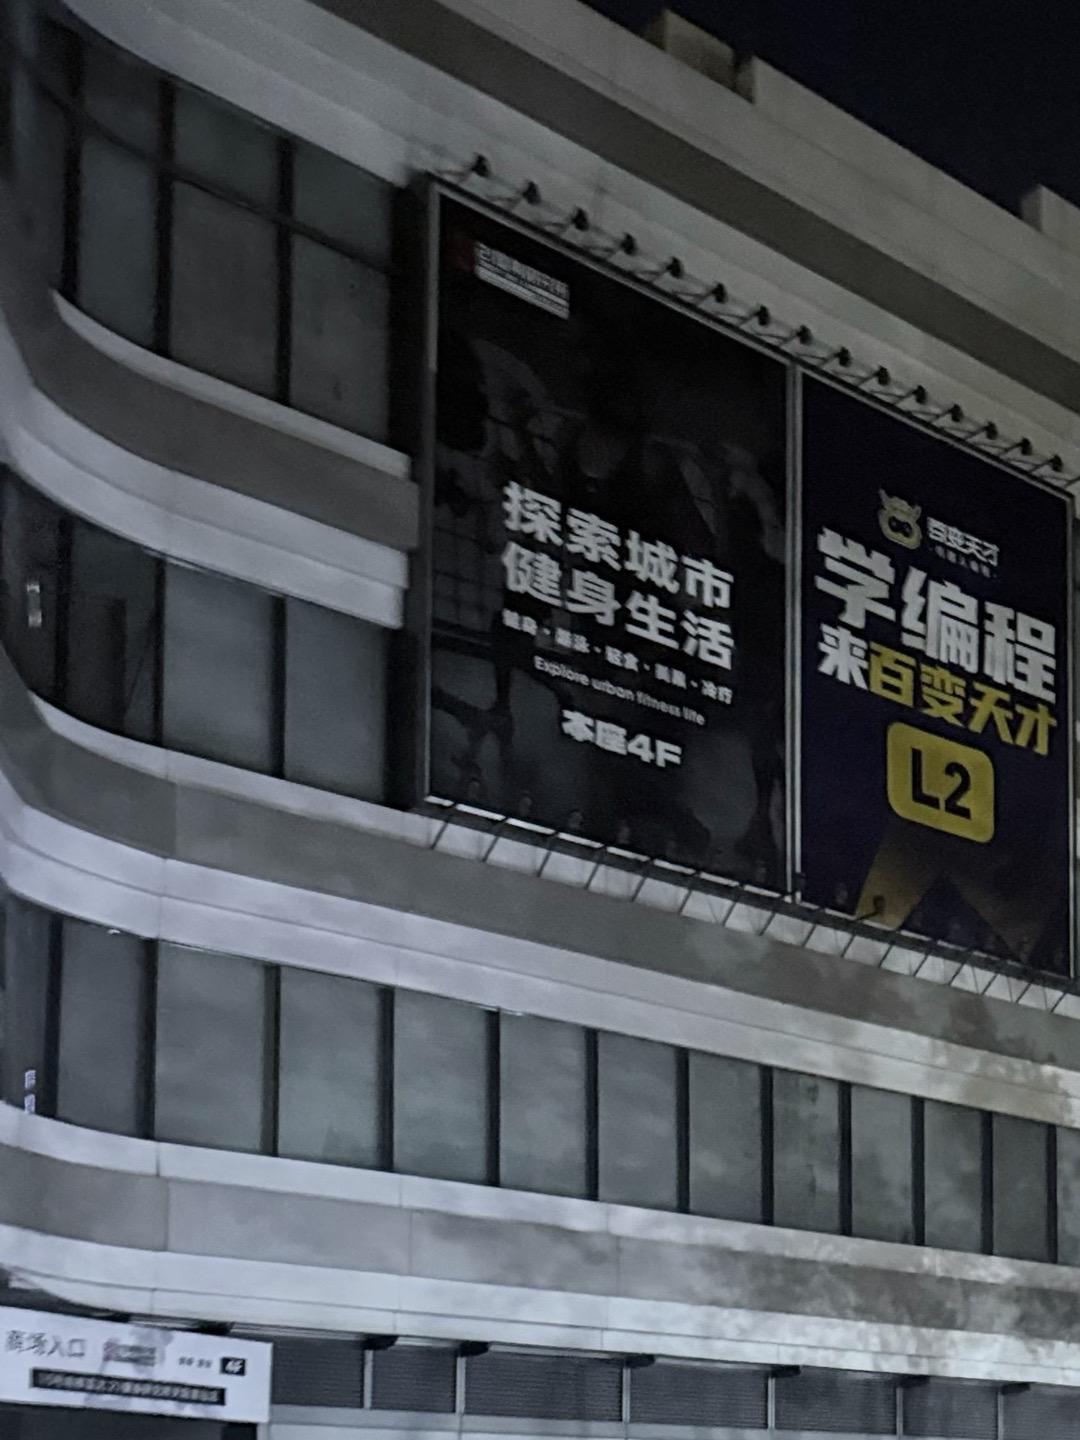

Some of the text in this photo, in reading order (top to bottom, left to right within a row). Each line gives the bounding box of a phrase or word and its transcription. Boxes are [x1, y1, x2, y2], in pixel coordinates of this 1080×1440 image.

[501, 540, 735, 671] 健身生活
[502, 480, 735, 609] 探索城市
[533, 654, 590, 686] Explore
[591, 675, 635, 702] urban
[813, 525, 1057, 704] 学编程
[817, 622, 1058, 757] 来百变天才
[910, 746, 972, 821] L2
